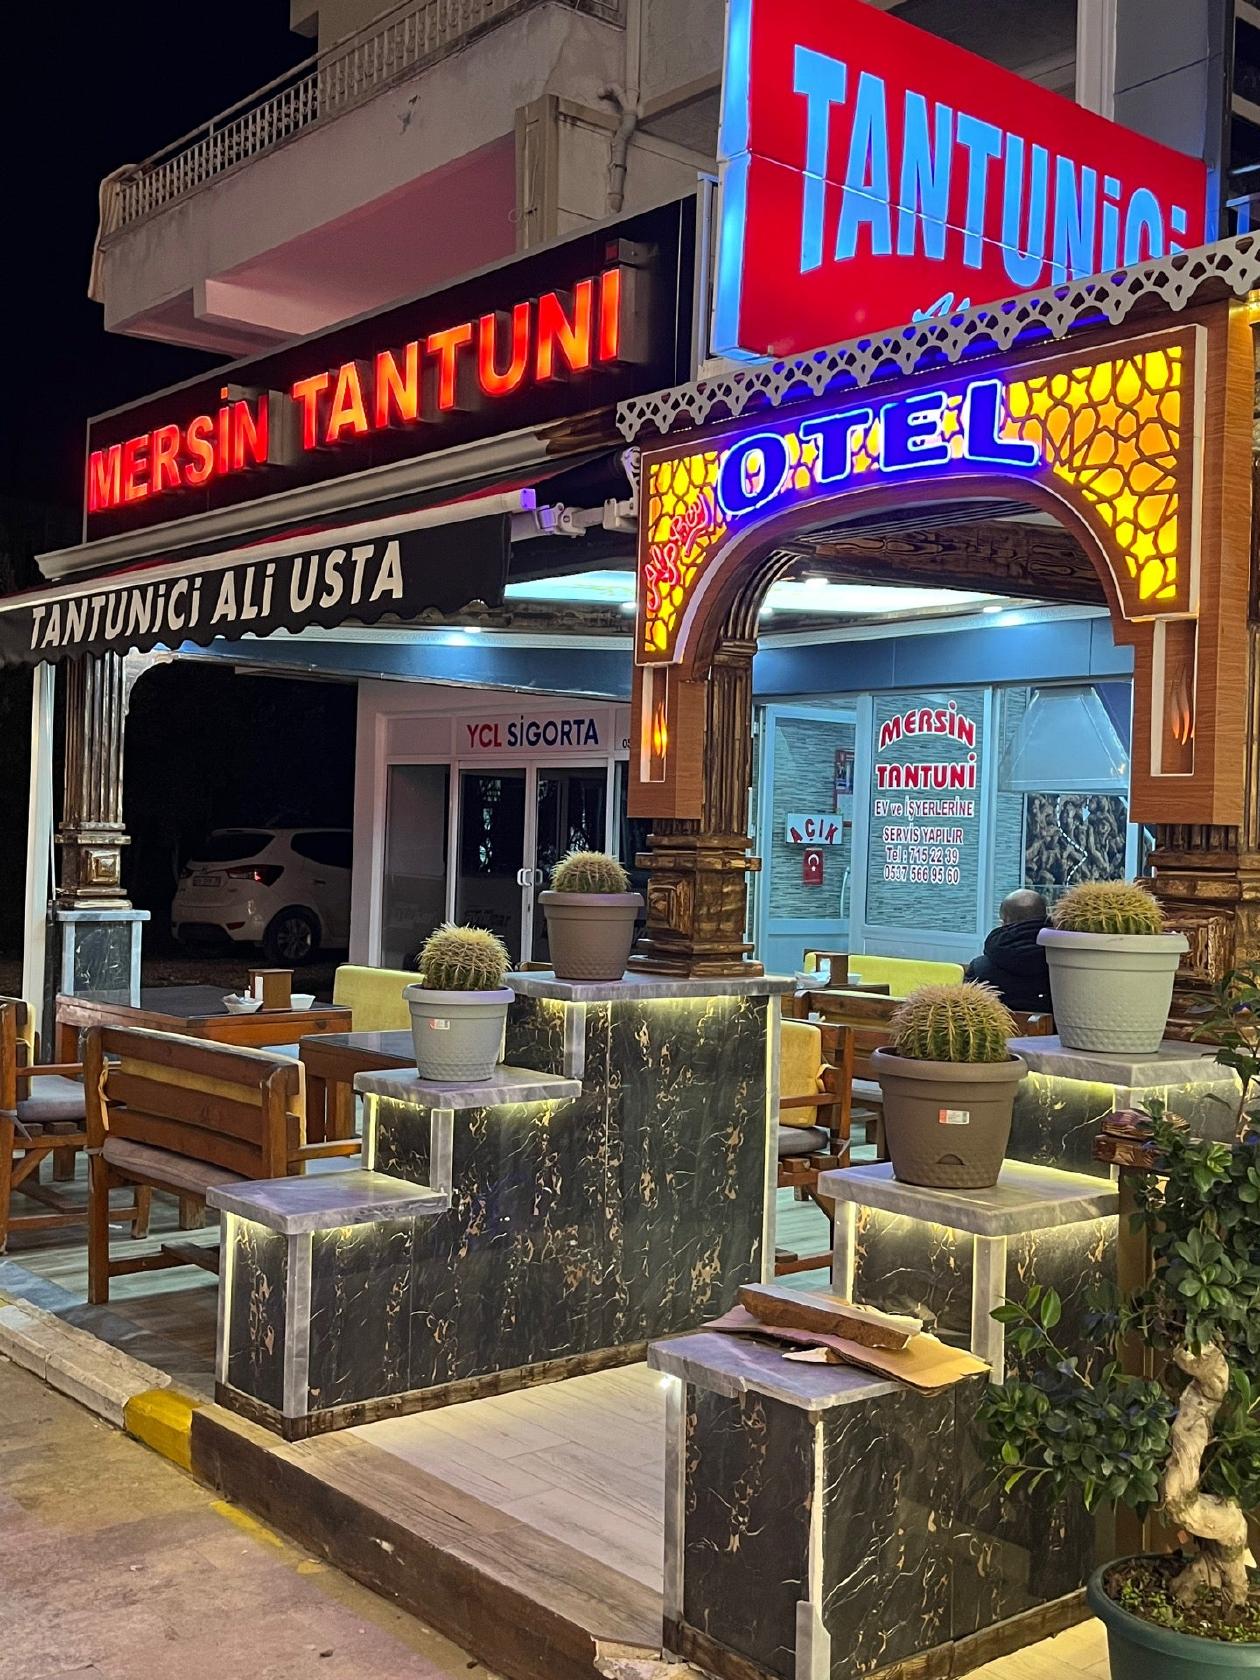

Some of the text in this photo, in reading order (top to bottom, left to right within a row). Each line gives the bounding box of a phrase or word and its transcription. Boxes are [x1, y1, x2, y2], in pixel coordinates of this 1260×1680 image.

[87, 385, 269, 514] MERSİN
[716, 378, 1042, 516] OTEL
[289, 540, 404, 613] USTA
[467, 715, 599, 748] YCL SİGORTA
[878, 700, 977, 752] MERSİN
[876, 752, 977, 789] TANTUNİ
[874, 800, 889, 816] EV
[890, 803, 903, 816] ve
[789, 818, 839, 845] AÇIK
[883, 823, 964, 845] SERVİS YAPILIR
[909, 846, 928, 864] 715
[929, 846, 943, 864] 22
[945, 847, 959, 865] 39
[910, 865, 929, 883] 566
[931, 866, 944, 884] 95
[946, 867, 960, 885] 60
